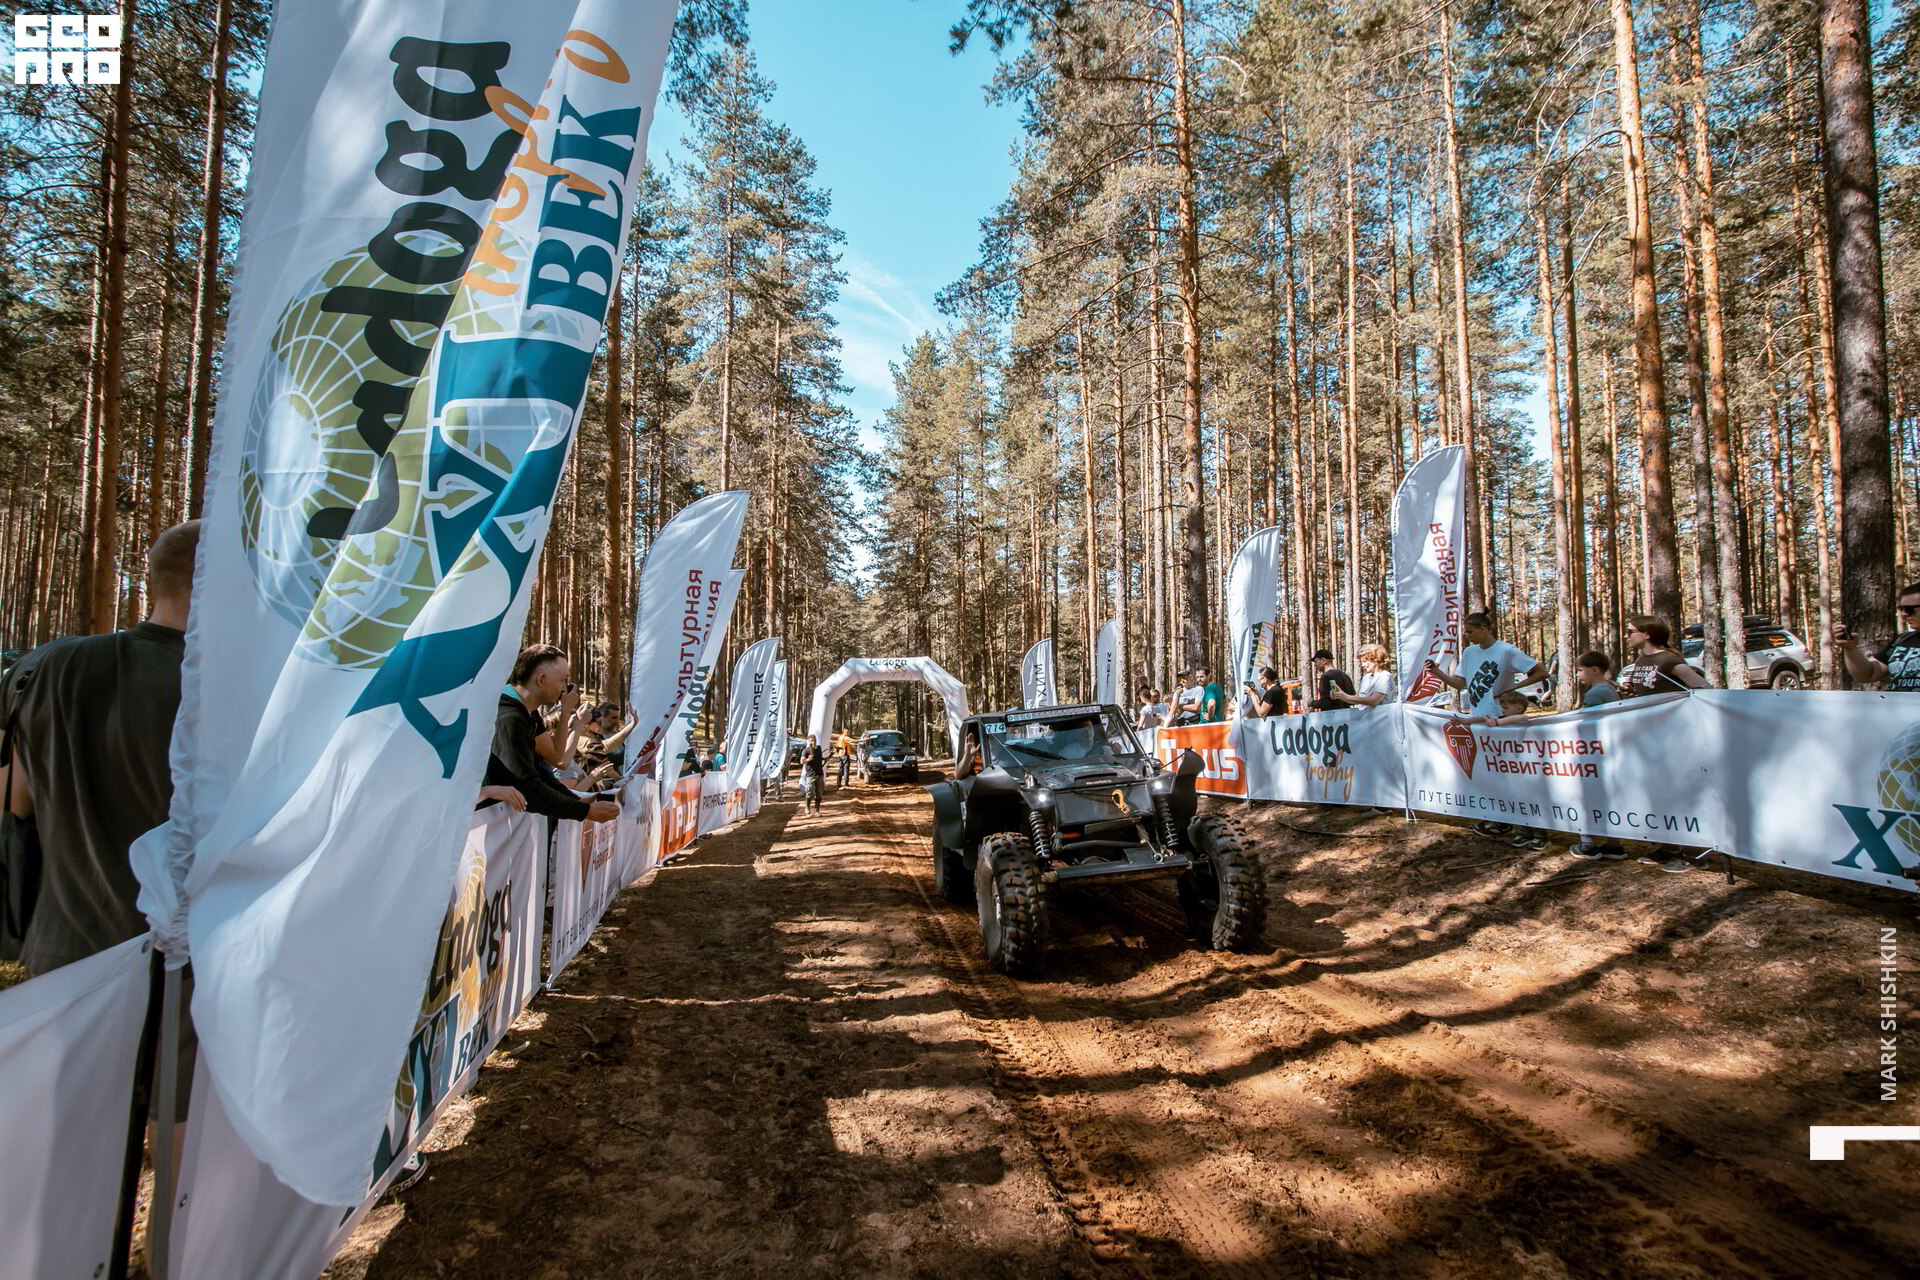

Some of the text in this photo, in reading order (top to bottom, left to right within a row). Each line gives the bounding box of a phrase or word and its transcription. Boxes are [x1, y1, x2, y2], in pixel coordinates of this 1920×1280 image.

[306, 36, 511, 540] Ladoga
[1271, 716, 1352, 768] Ladoga
[1479, 735, 1605, 757] Культурная
[1485, 755, 1599, 779] Навигация
[1306, 750, 1354, 803] trophy
[1418, 788, 1701, 833] ПУТЕШЕСТВУЕМ ПО РОССИИ
[428, 879, 512, 1003] Ladoga
